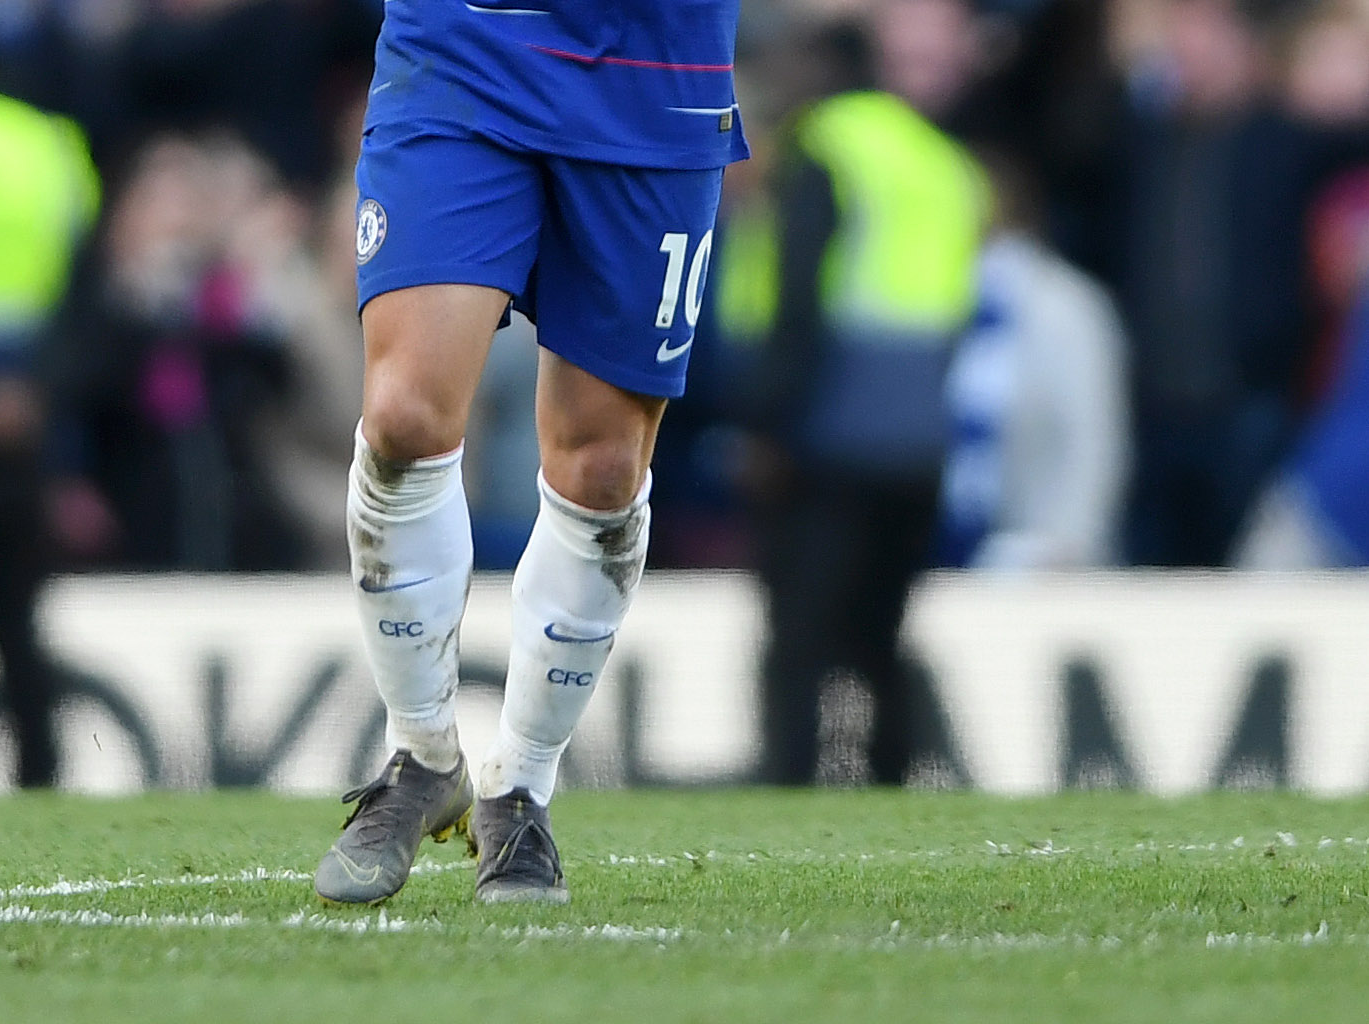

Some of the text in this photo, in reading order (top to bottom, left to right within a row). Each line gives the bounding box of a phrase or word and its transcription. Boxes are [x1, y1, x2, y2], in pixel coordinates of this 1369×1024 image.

[655, 228, 713, 328] 10
[378, 619, 424, 637] CFC
[546, 667, 593, 687] CFC
